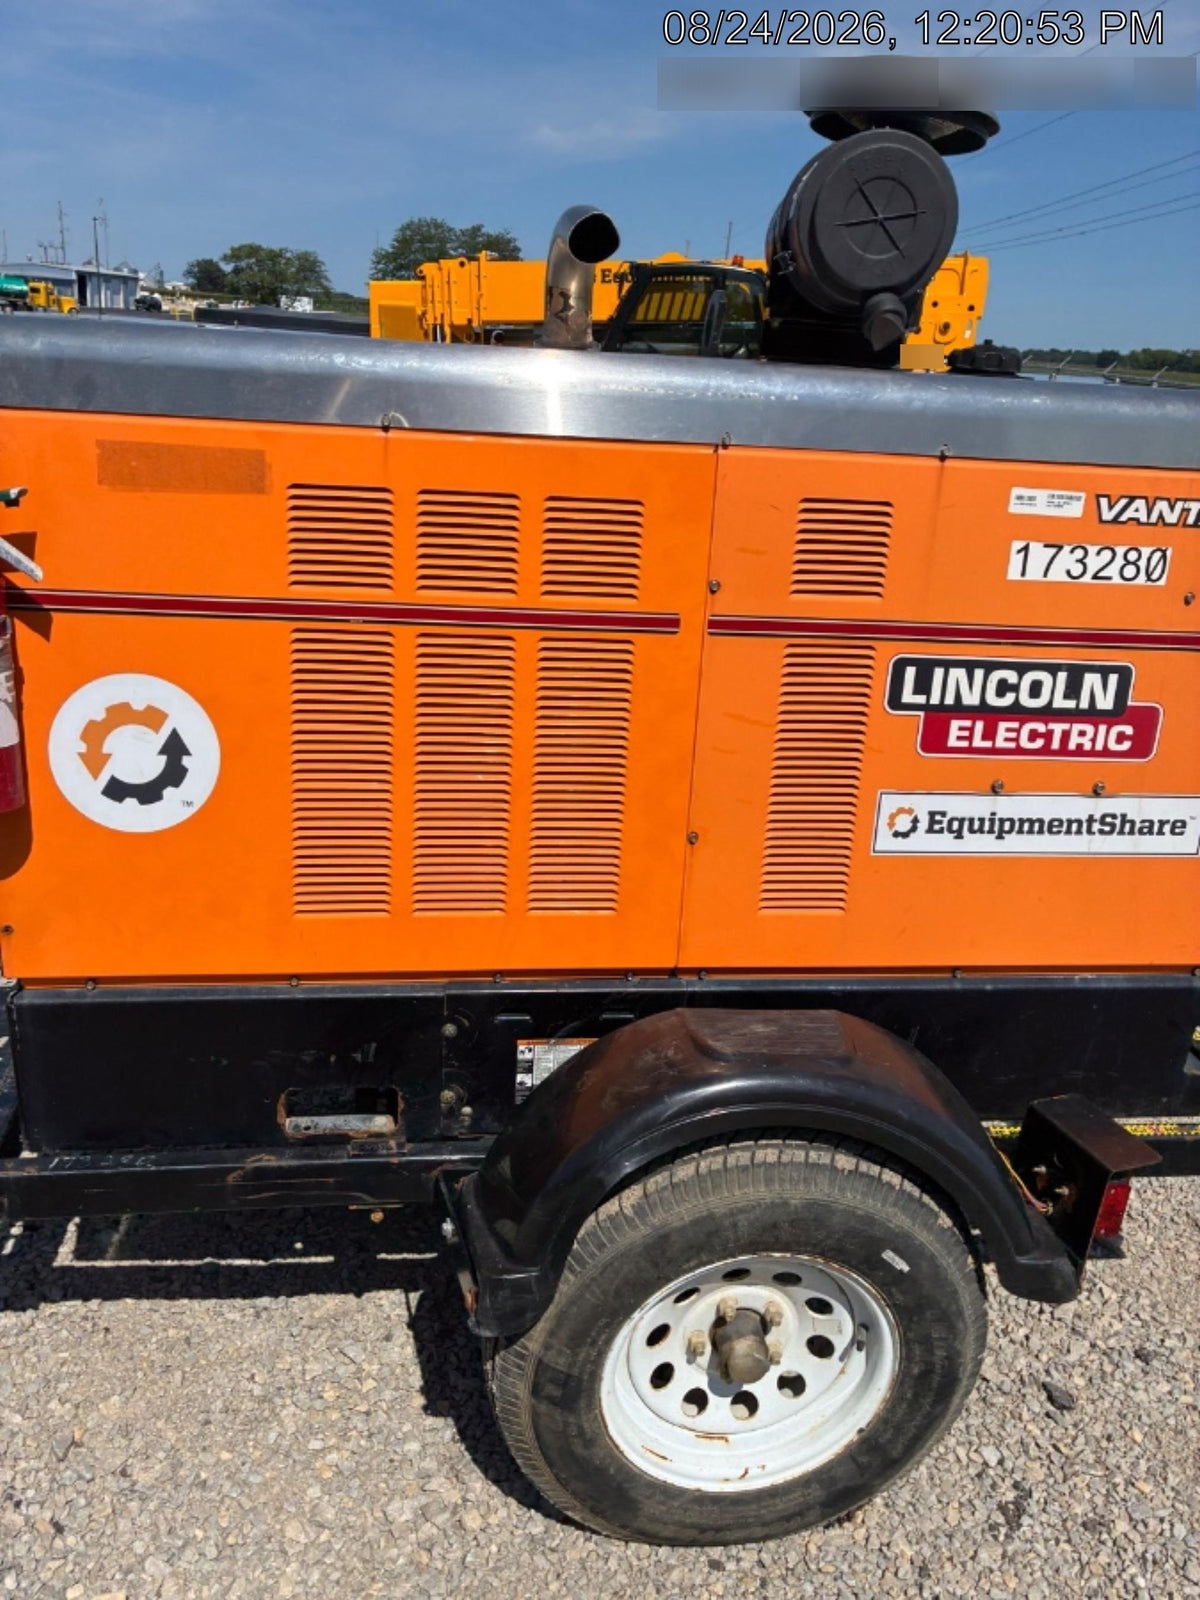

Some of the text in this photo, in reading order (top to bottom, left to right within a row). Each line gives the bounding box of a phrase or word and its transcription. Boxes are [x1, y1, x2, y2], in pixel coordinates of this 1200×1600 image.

[1096, 494, 1200, 528] VANT
[1016, 542, 1168, 583] 173280
[901, 666, 1119, 710] LINCOLN
[947, 719, 1134, 751] ELECTRIC
[925, 810, 1187, 839] EquipmentShare
